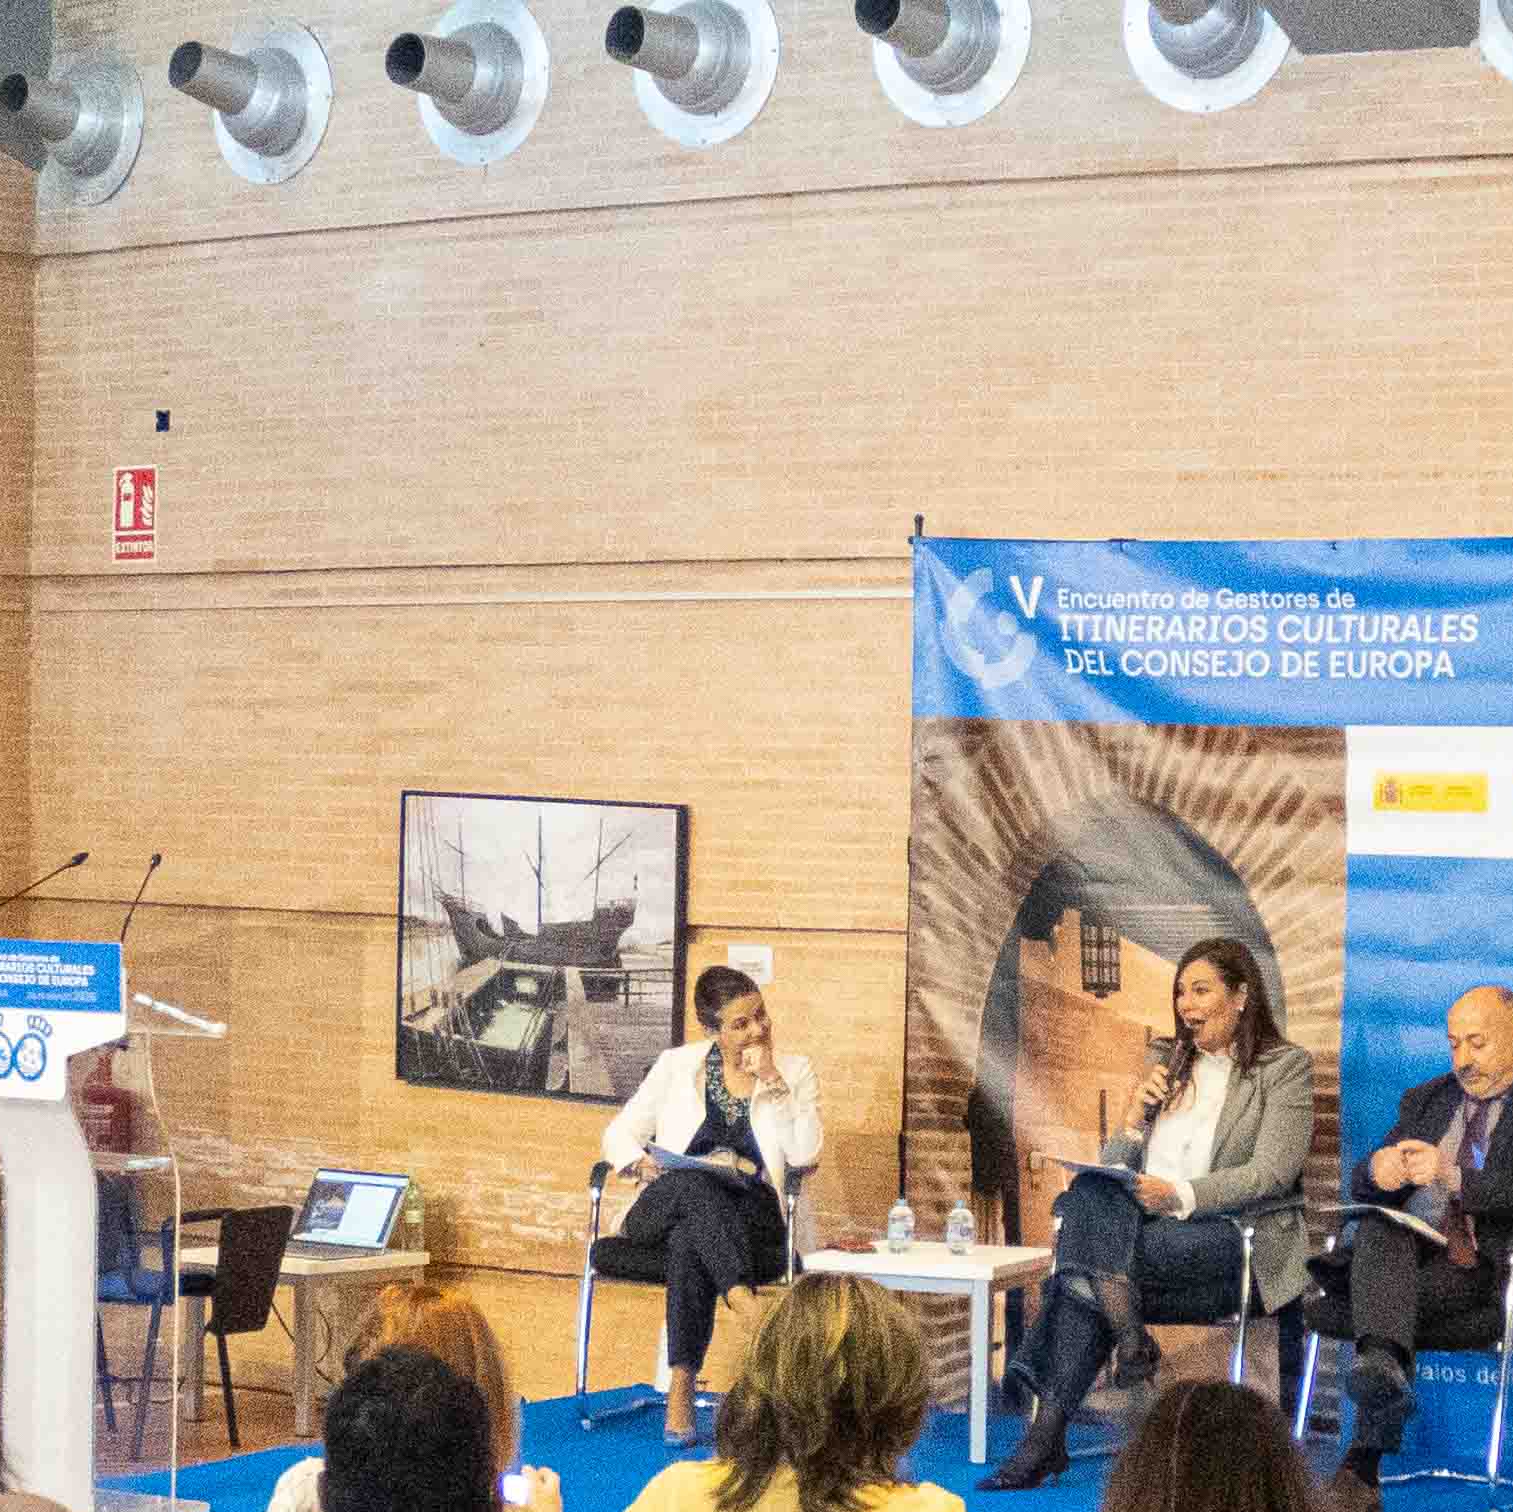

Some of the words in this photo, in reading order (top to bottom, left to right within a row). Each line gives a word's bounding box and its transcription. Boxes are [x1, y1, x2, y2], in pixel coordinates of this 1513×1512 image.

[1009, 575, 1043, 618] V
[1057, 588, 1175, 609] Encuentro
[1181, 587, 1209, 609] de
[1216, 587, 1320, 609] Gestores
[1326, 587, 1356, 609] de
[1059, 613, 1268, 643] ITINERARIOS
[1277, 613, 1479, 643] CULTURALES
[1064, 648, 1114, 676] DEL
[1121, 649, 1270, 678] CONSEJO
[1280, 650, 1320, 679] DE
[1329, 650, 1456, 680] EUROPA
